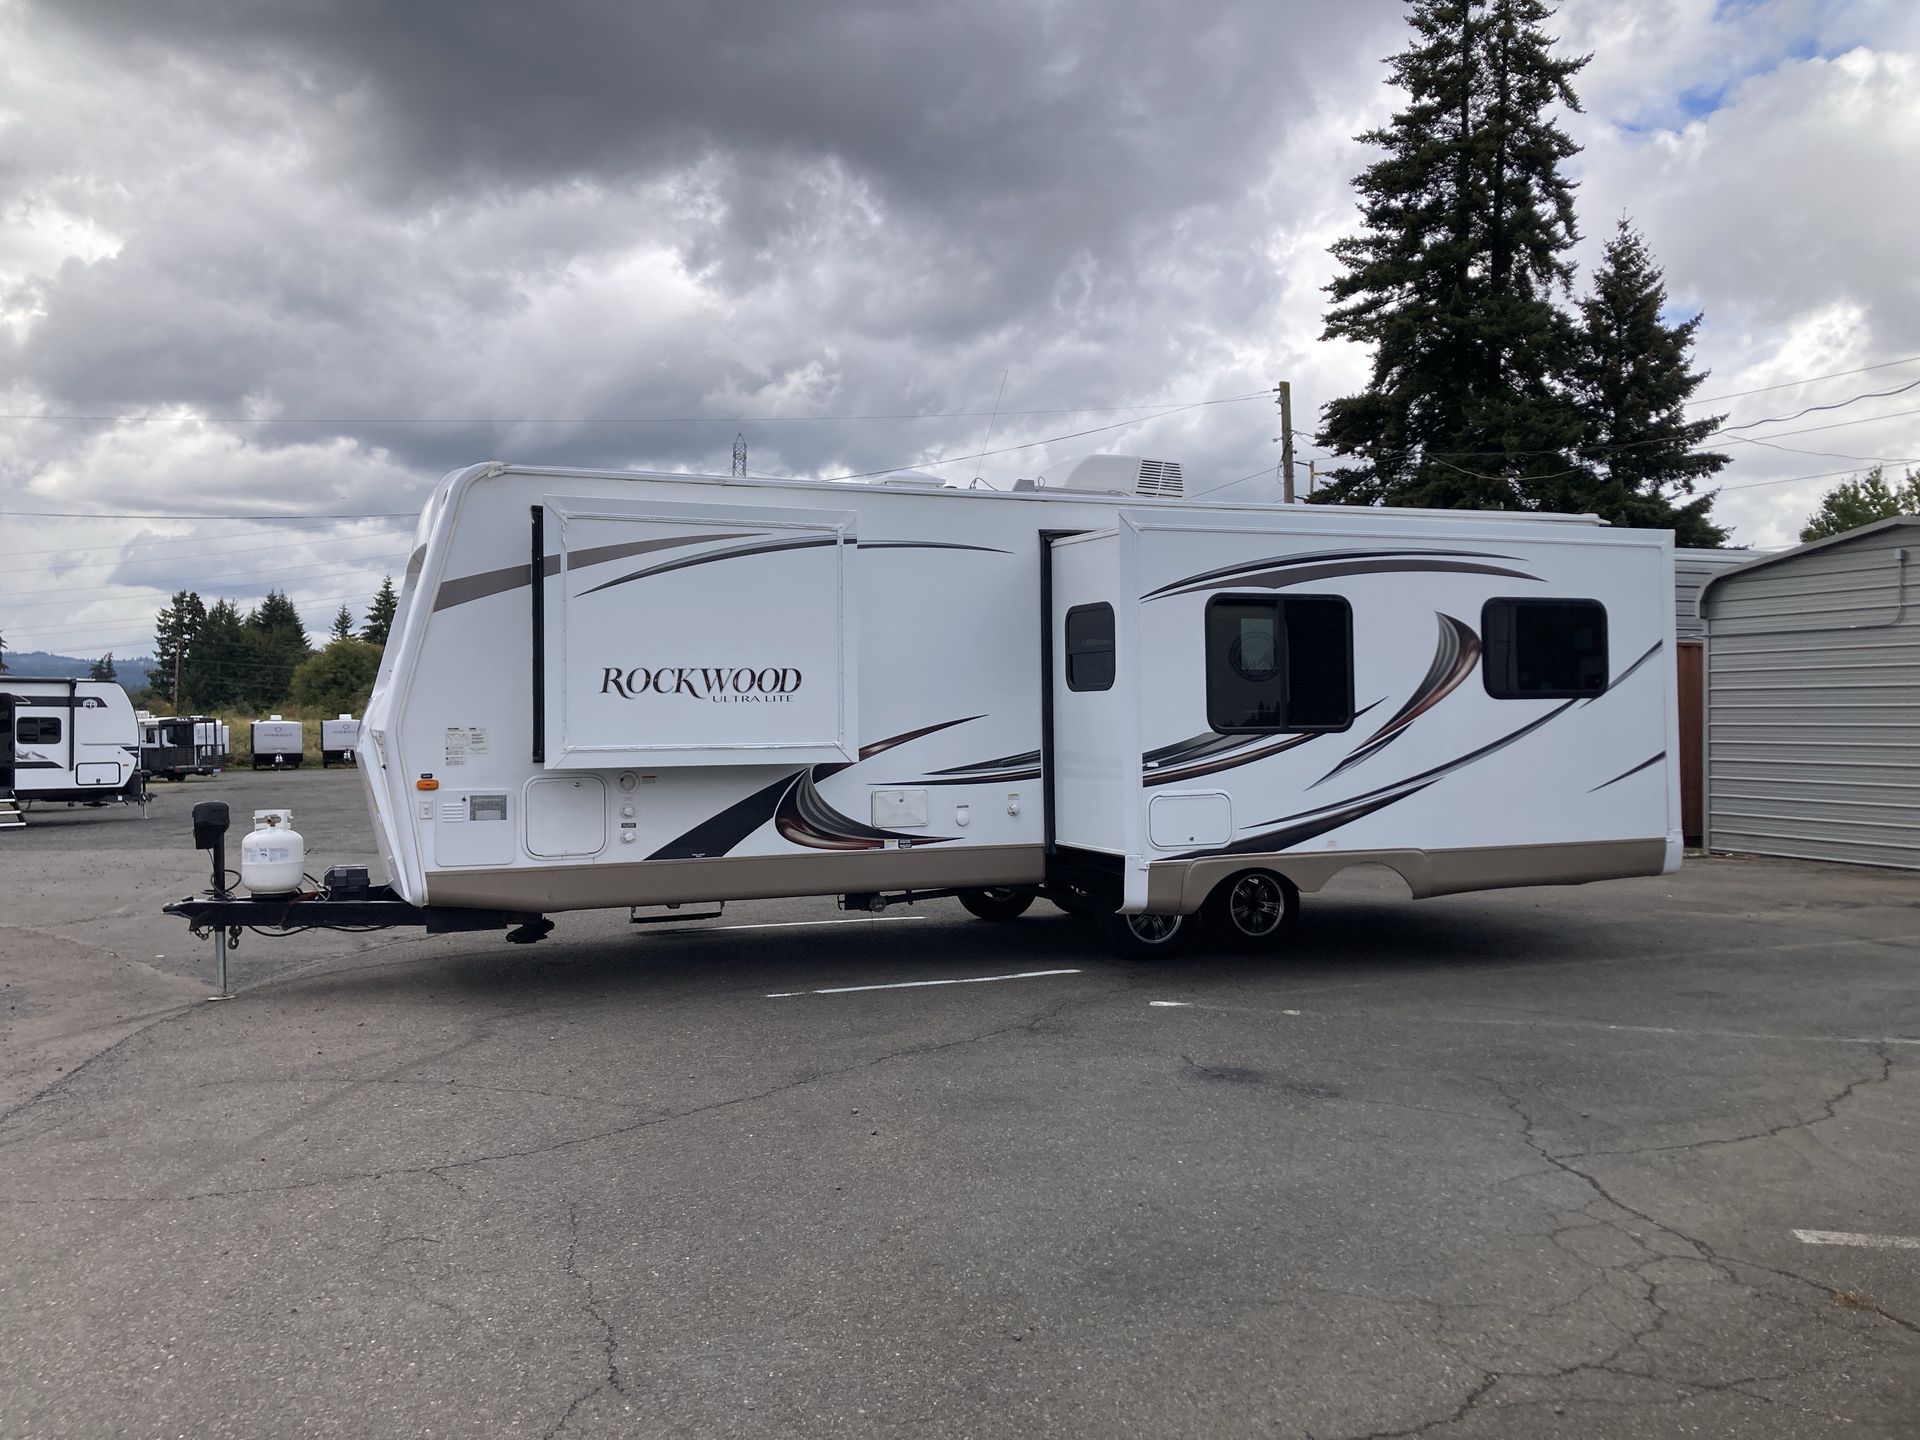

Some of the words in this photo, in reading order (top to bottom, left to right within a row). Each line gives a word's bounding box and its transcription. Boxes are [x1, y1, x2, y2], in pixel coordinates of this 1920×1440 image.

[599, 667, 802, 700] ROCKWOOD
[712, 695, 760, 703] ULTRA
[765, 694, 795, 703] LITE
